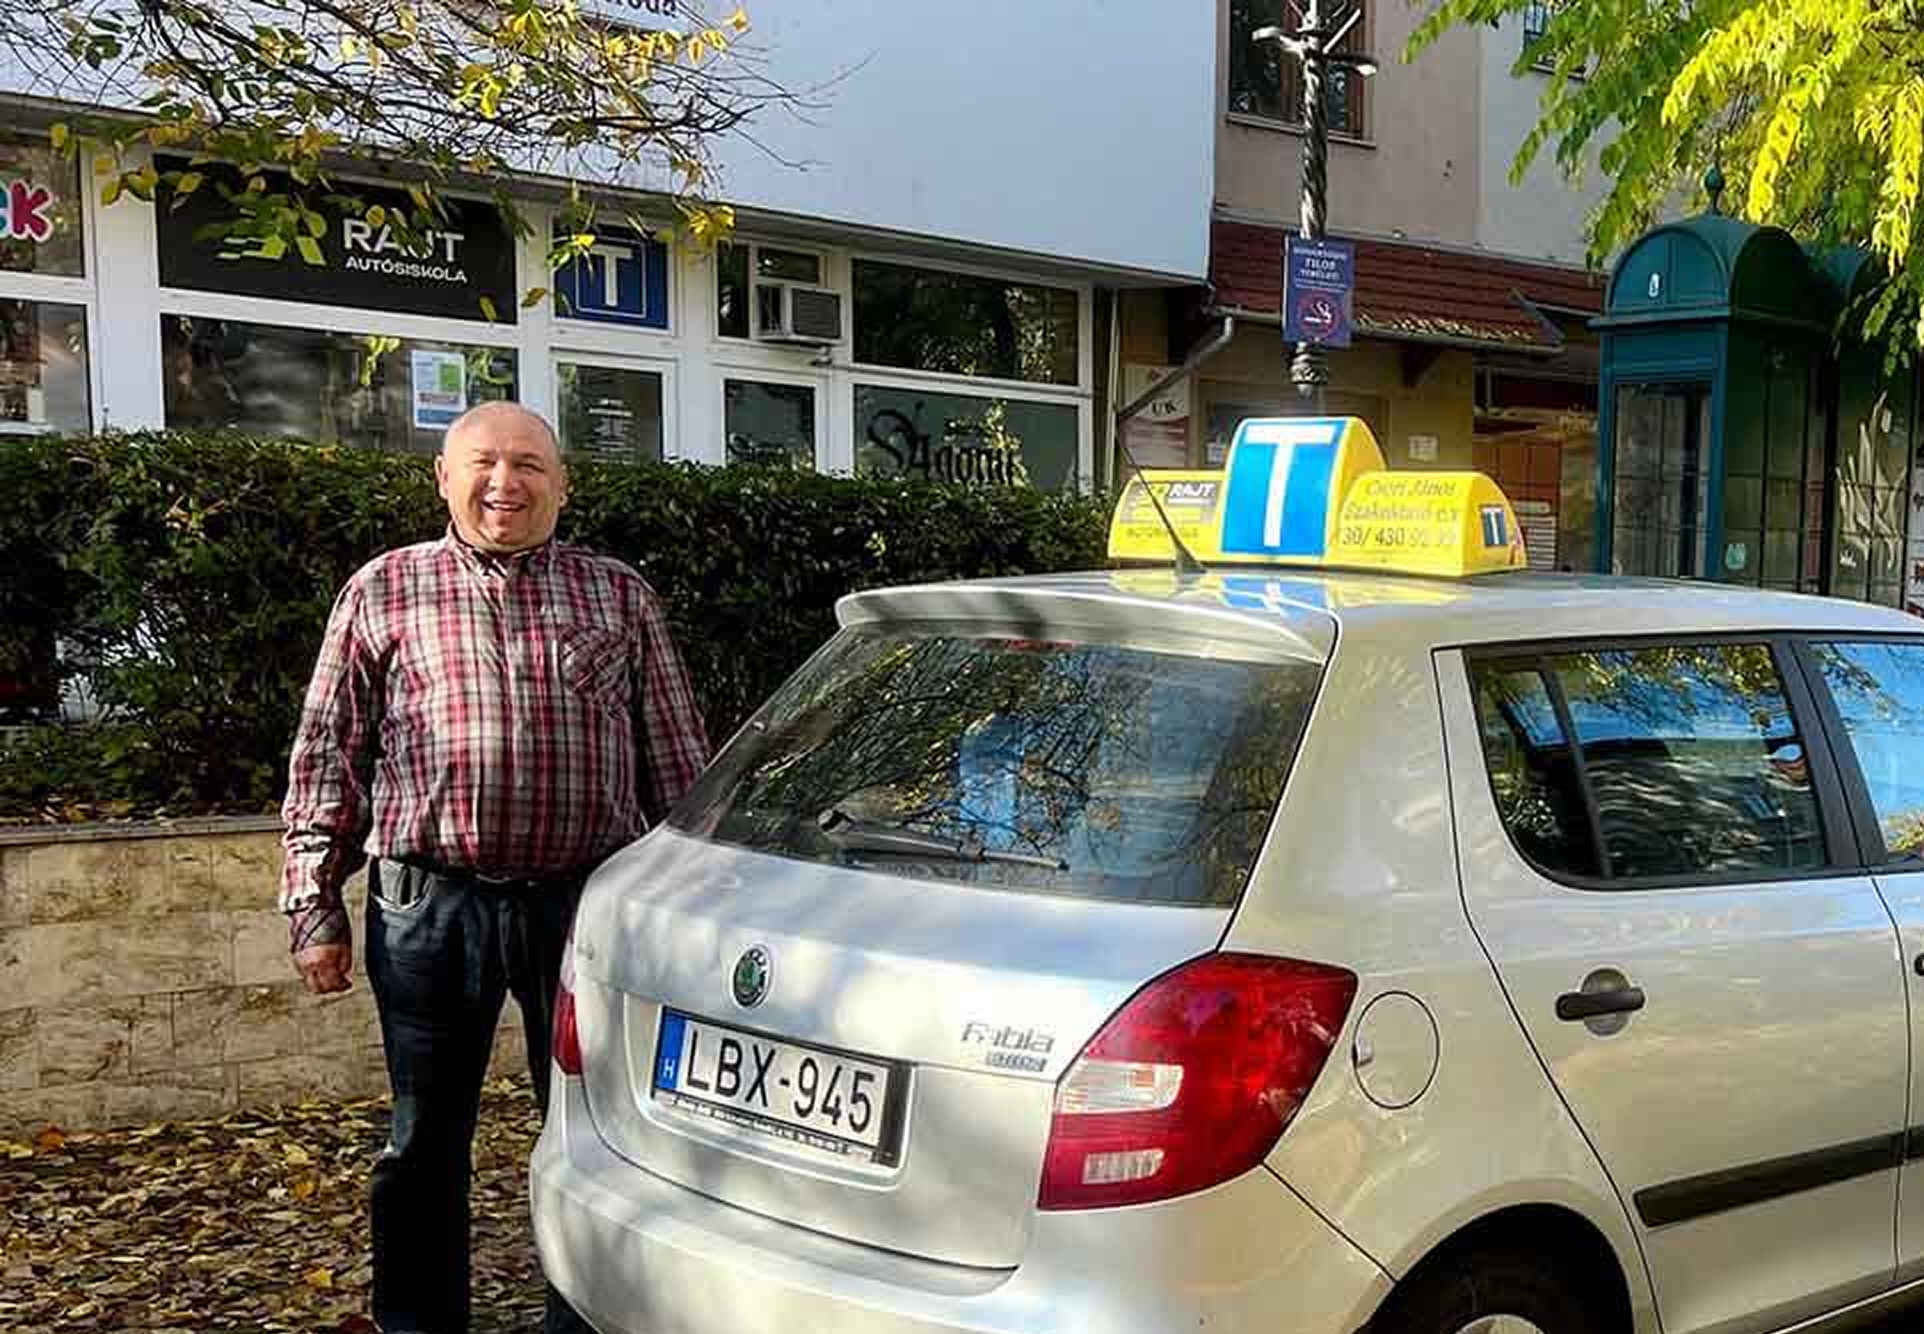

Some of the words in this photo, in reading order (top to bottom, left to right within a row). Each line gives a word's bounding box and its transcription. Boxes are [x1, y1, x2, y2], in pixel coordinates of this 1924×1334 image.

[344, 255, 468, 284] AUTÓSISKOLA
[589, 243, 633, 307] T
[1244, 424, 1336, 547] T
[1480, 506, 1506, 546] T
[663, 1058, 676, 1078] H
[686, 1030, 875, 1133] LBX-945
